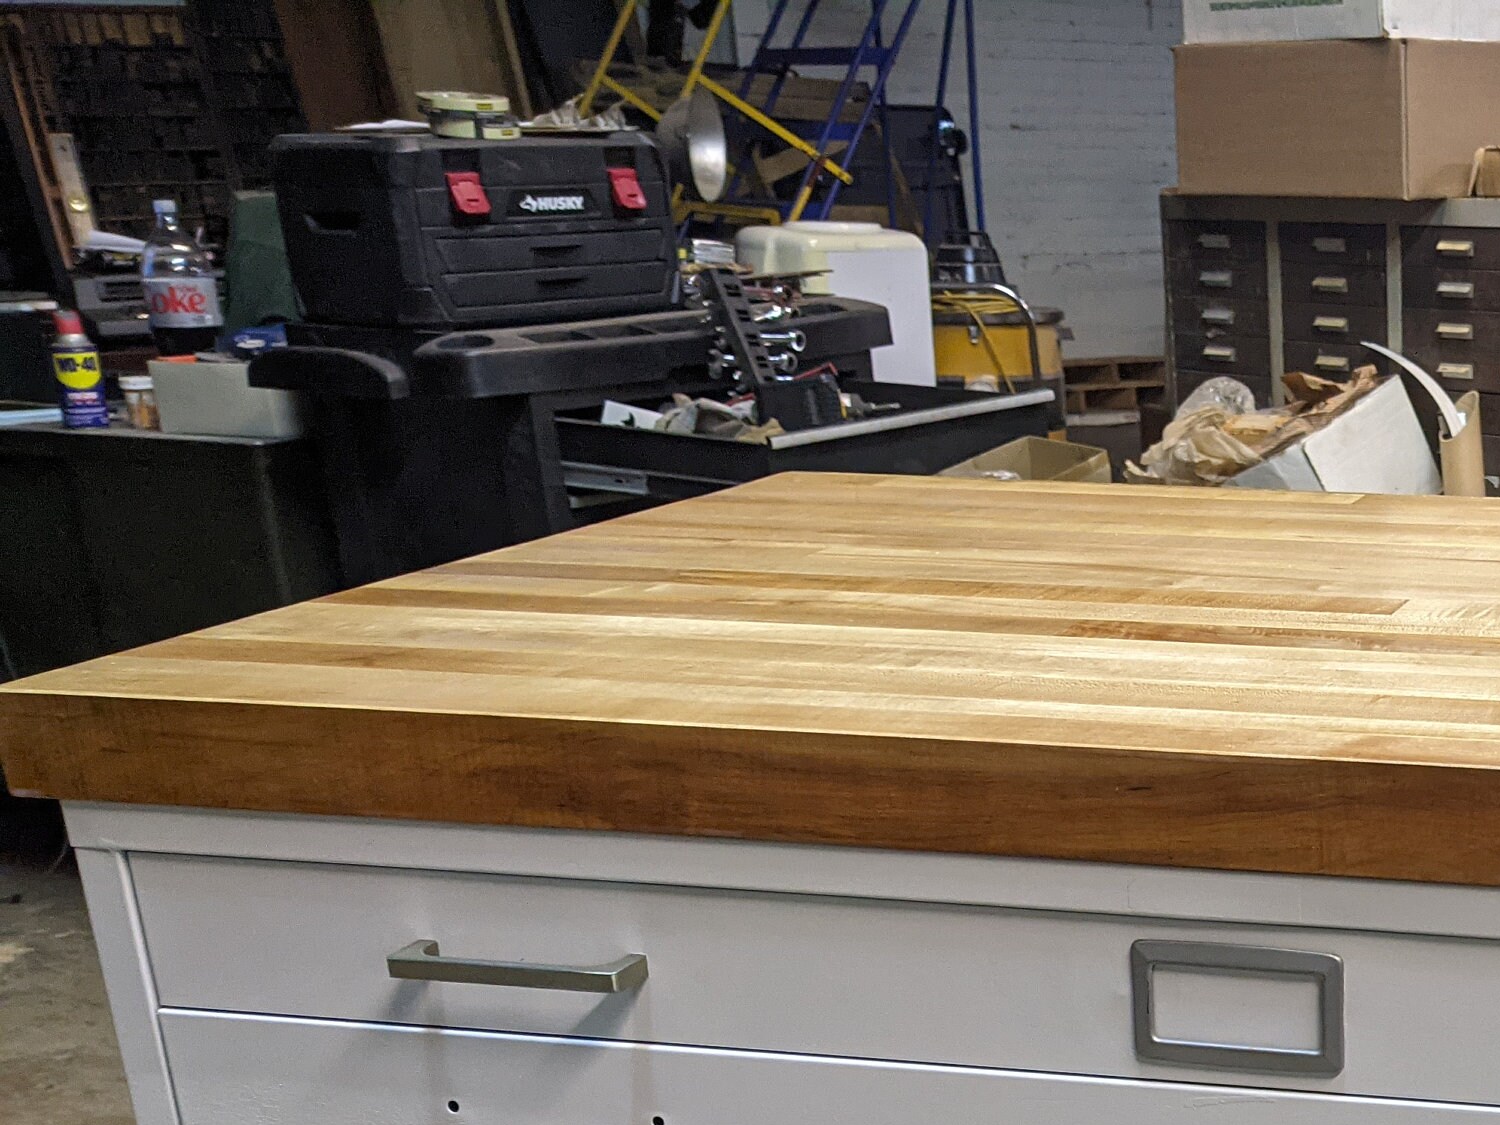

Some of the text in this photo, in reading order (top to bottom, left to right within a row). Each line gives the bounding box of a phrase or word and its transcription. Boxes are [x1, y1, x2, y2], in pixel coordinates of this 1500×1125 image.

[536, 195, 585, 211] HUSKY
[151, 286, 207, 314] oke
[55, 356, 97, 372] WD-40
